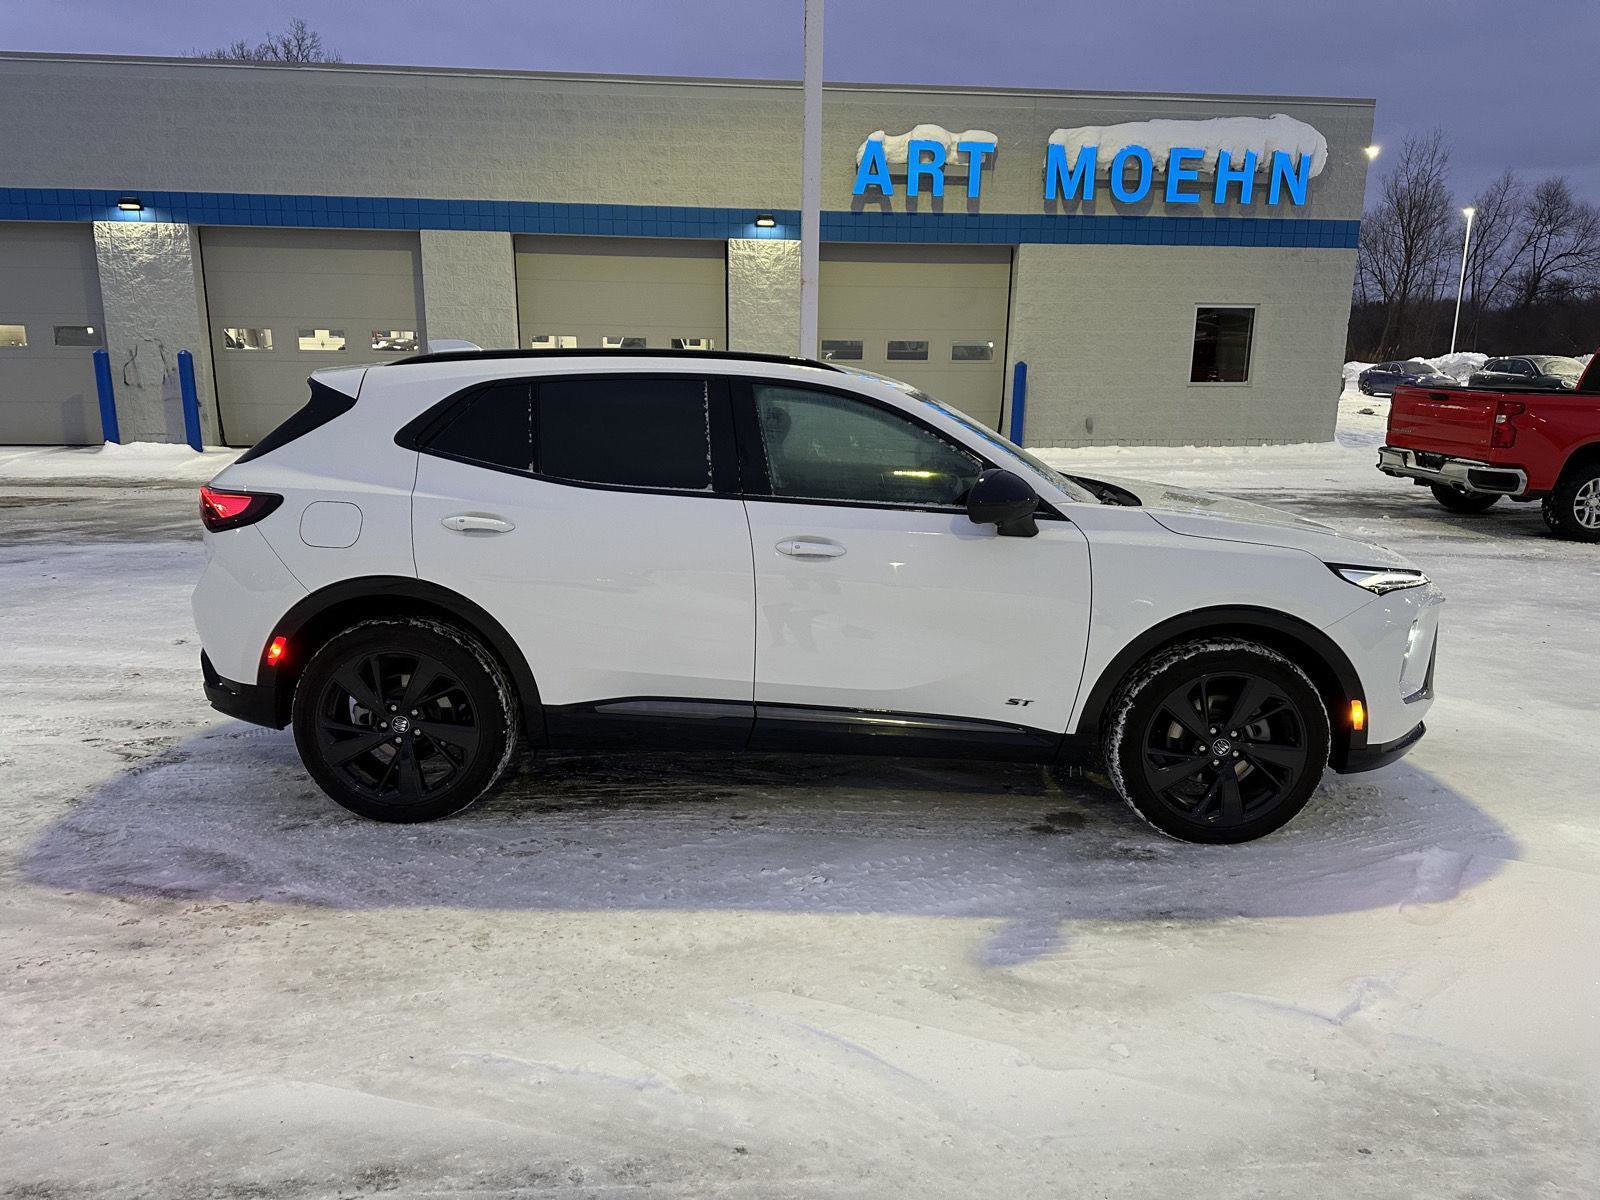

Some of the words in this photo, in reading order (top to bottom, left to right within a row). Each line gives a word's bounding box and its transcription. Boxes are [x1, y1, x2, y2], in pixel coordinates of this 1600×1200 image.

[852, 139, 996, 198] ART
[1044, 143, 1312, 206] MOEHN
[1005, 698, 1035, 707] ST
